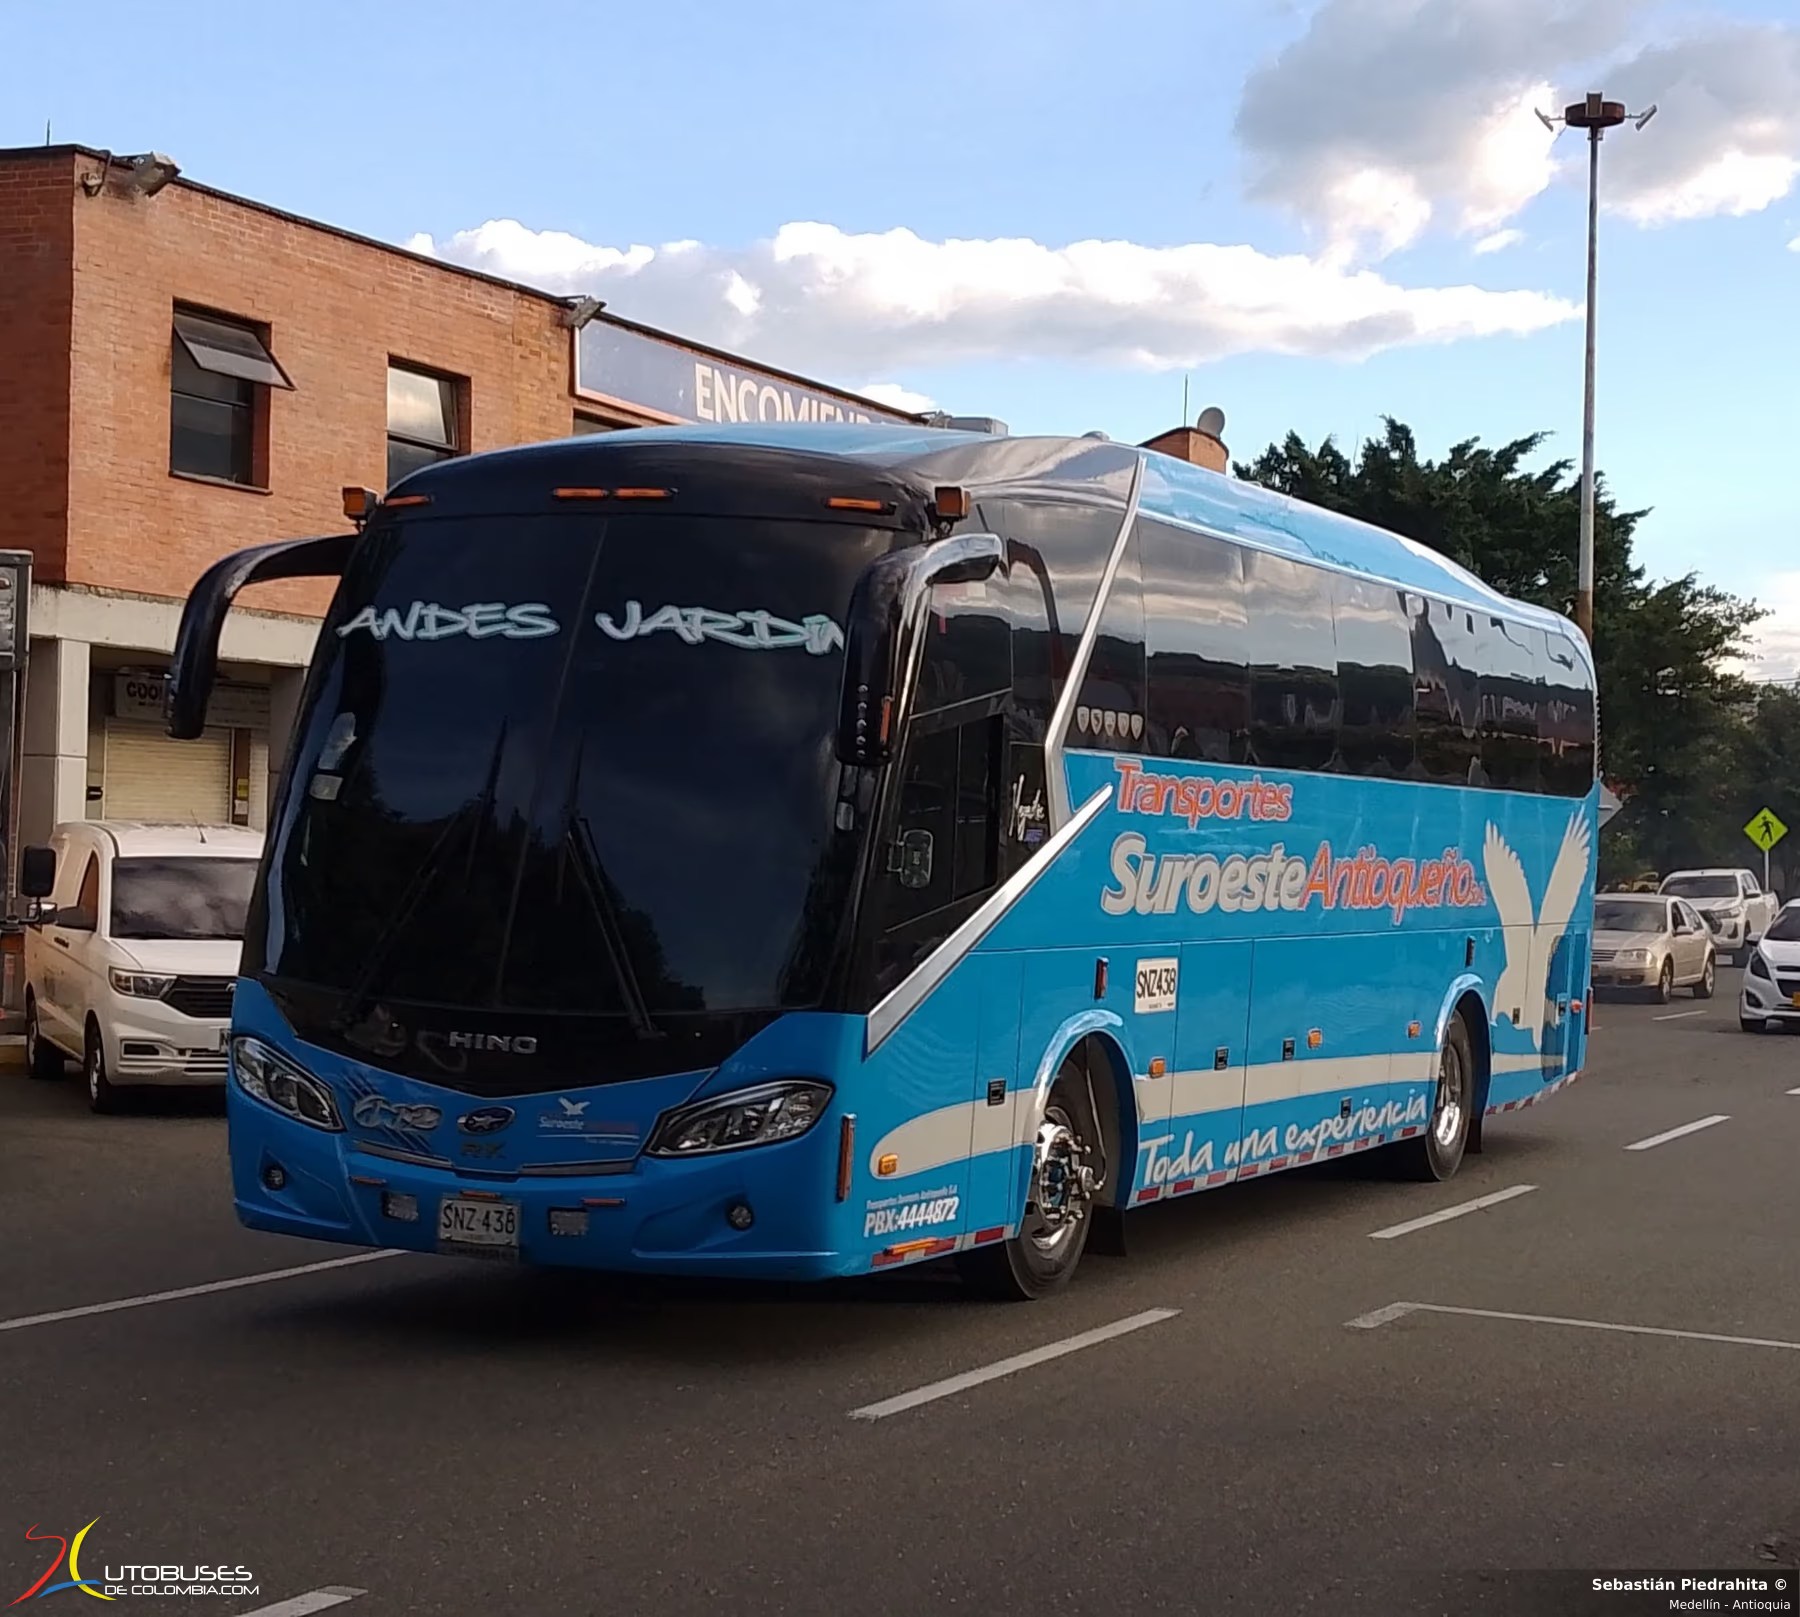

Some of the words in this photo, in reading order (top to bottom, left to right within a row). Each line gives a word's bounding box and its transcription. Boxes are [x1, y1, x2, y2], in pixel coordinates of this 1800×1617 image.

[695, 362, 888, 424] ENCOM
[336, 600, 560, 640] ANDES
[1114, 758, 1294, 830] Transportes
[1101, 832, 1307, 915] Suroeste
[1299, 840, 1474, 925] Antioqueño
[1136, 967, 1177, 999] SNZ438
[449, 1031, 537, 1054] HINO
[1140, 1129, 1214, 1186] Toda
[1223, 1125, 1278, 1167] una
[1285, 1088, 1427, 1161] experiencia
